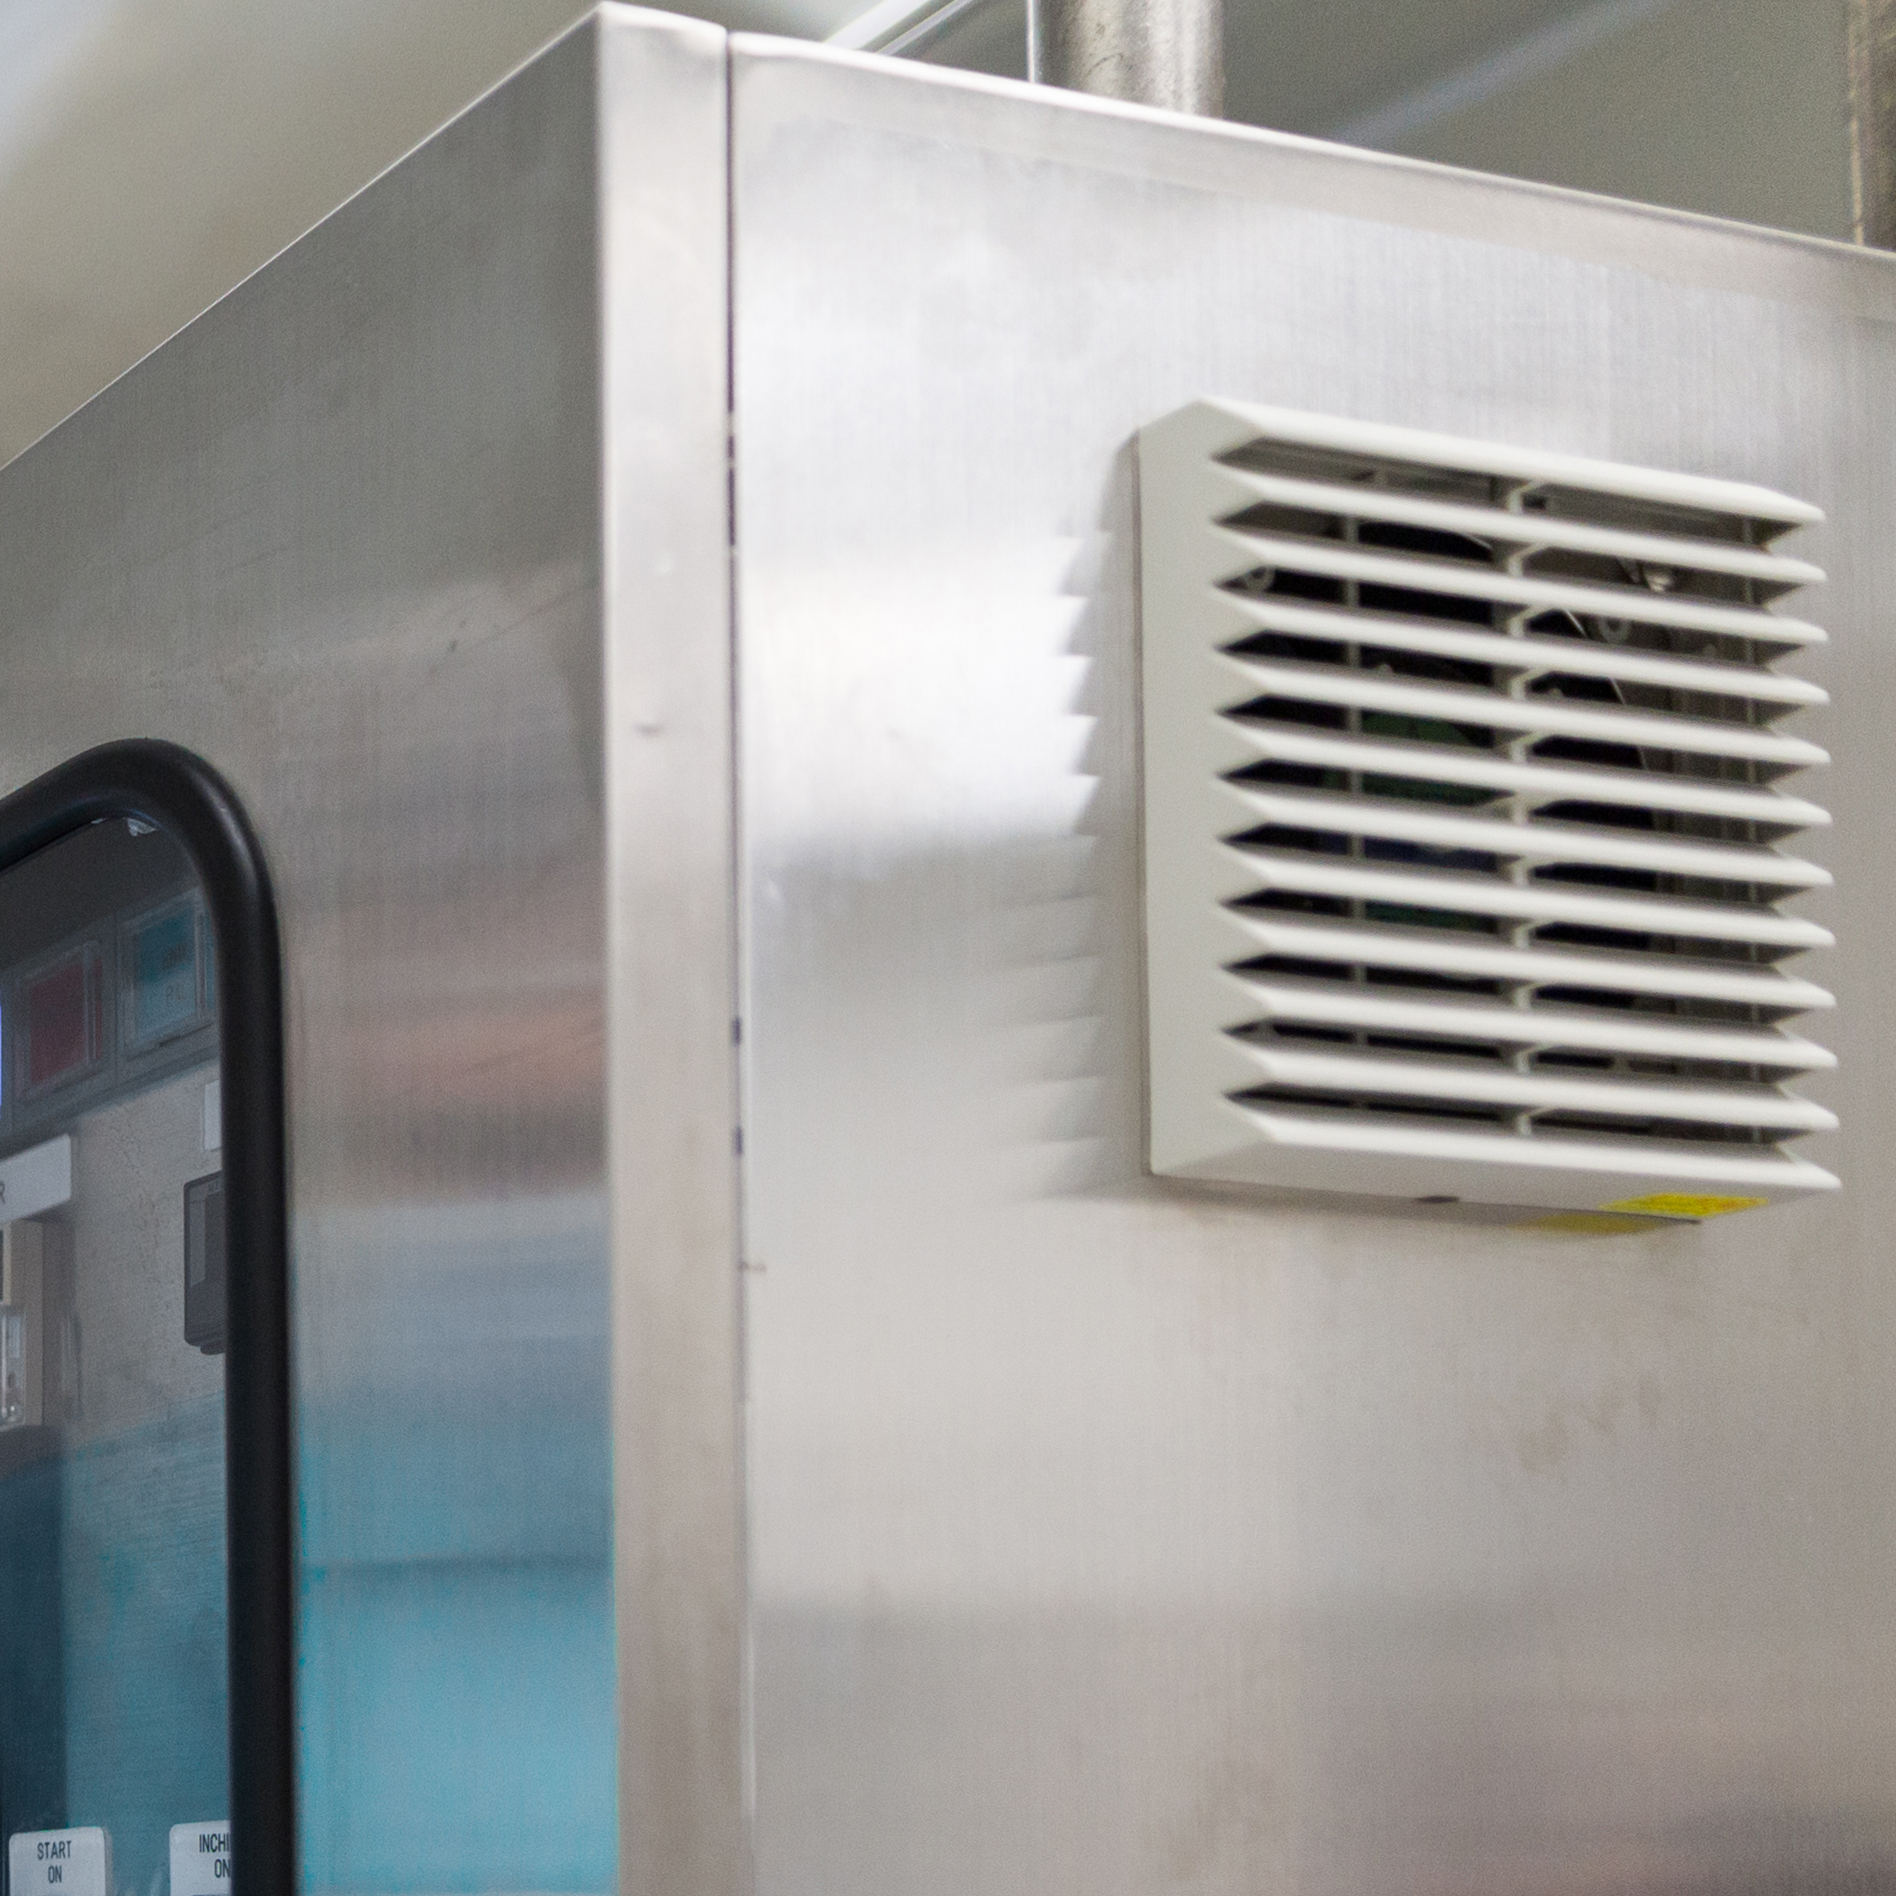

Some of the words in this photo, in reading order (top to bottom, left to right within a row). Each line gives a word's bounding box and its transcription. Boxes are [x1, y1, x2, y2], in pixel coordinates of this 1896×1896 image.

[37, 1840, 72, 1860] START
[47, 1865, 62, 1884] ON
[214, 1858, 231, 1878] ON
